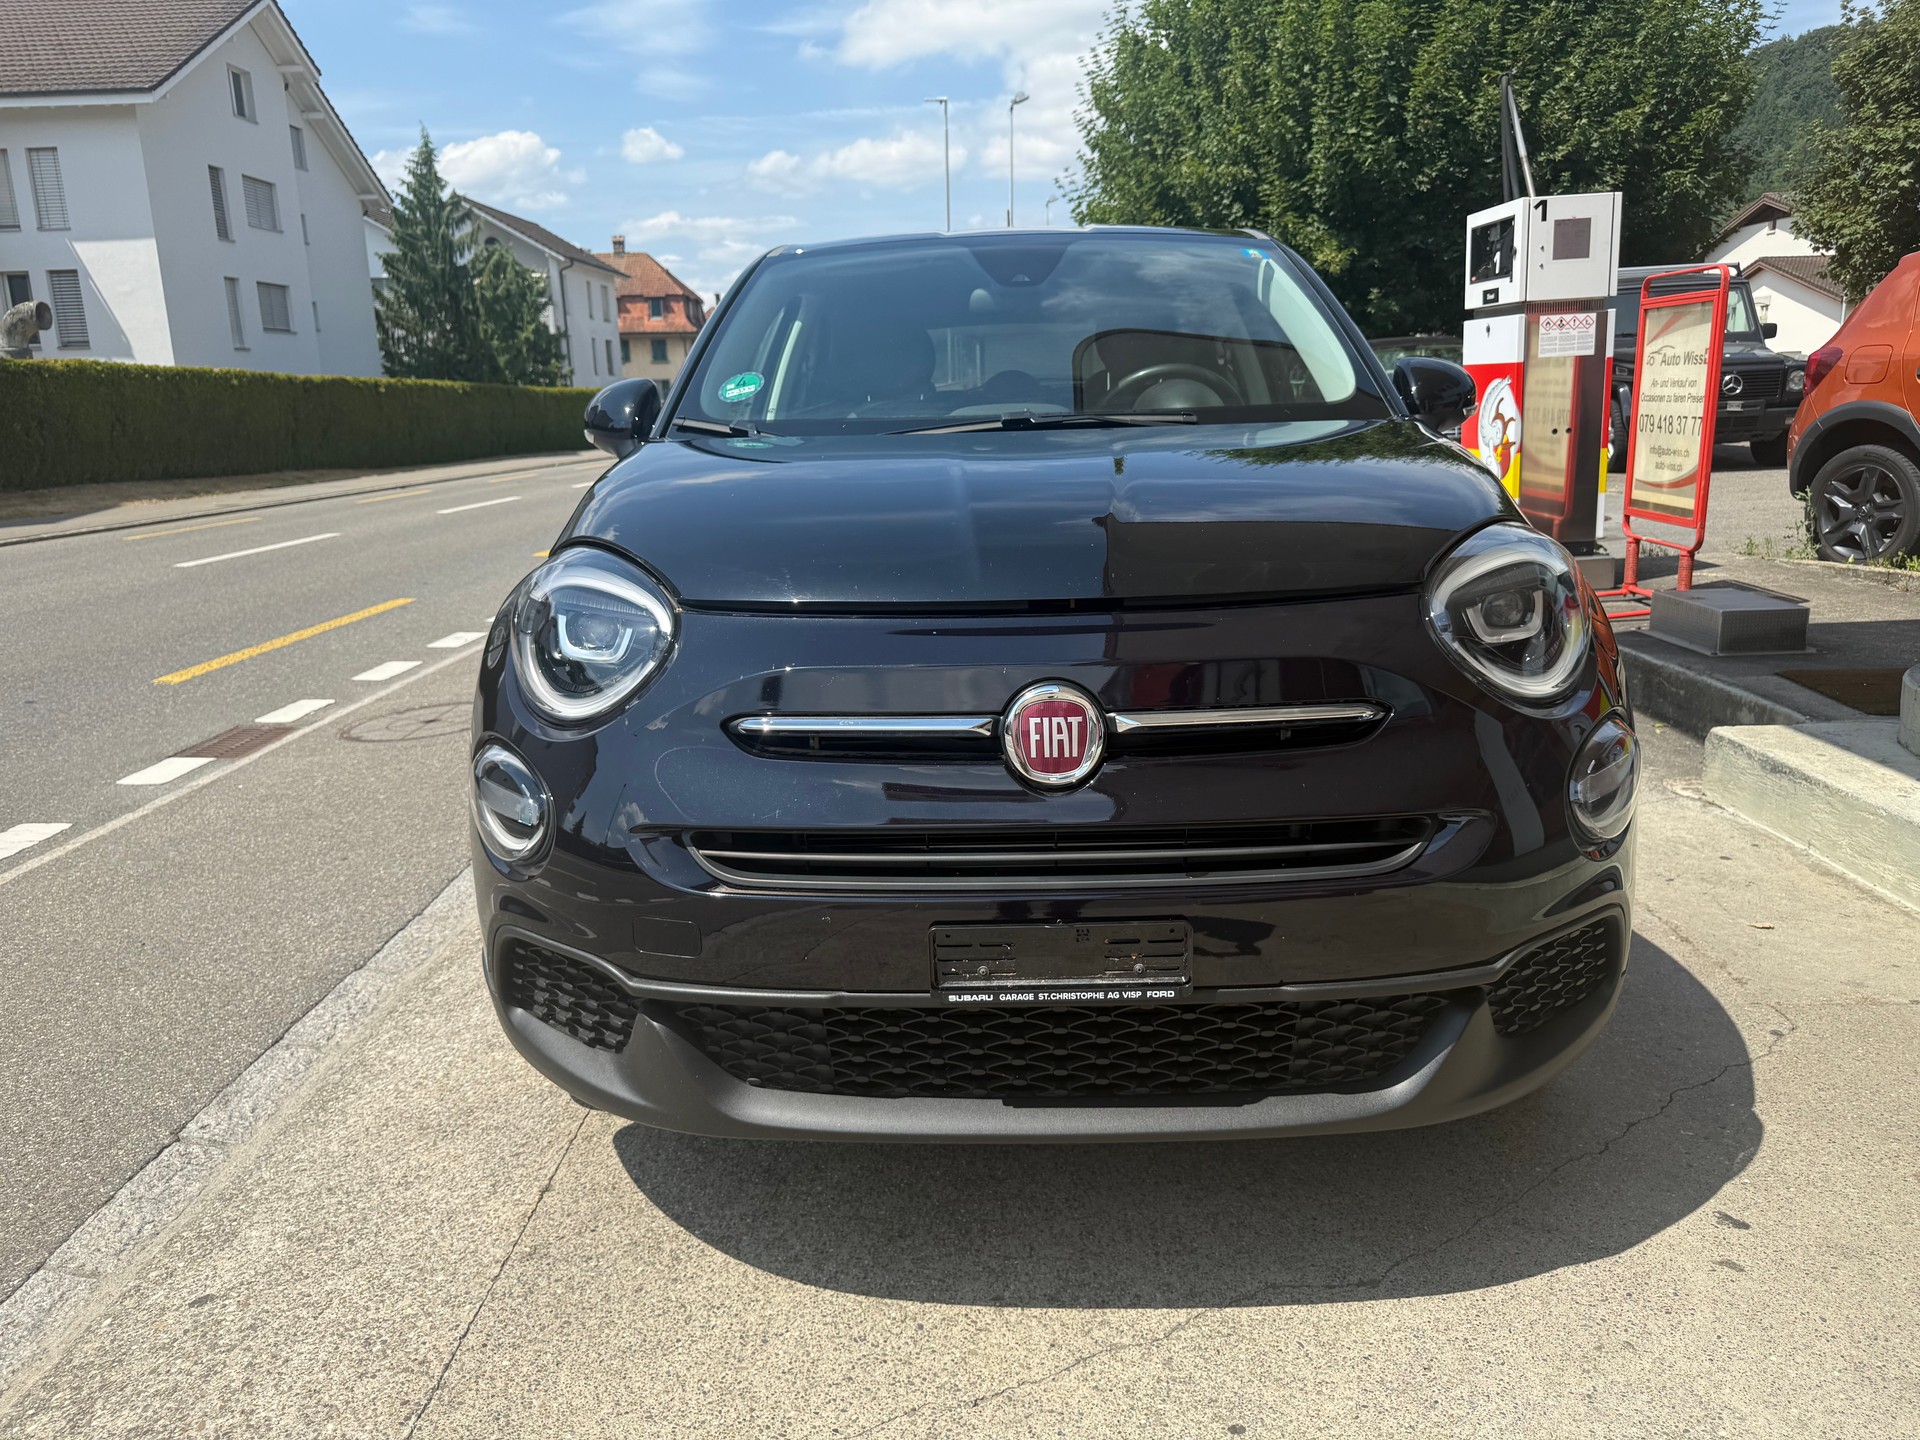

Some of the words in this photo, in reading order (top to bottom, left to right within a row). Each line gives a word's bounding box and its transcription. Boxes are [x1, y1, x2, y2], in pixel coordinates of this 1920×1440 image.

[1533, 199, 1548, 222] 1
[1493, 250, 1501, 274] 1
[1660, 352, 1681, 366] Auto
[1670, 378, 1689, 388] Verkauf
[1640, 392, 1666, 403] Occasionen
[1666, 394, 1672, 403] zu
[1673, 392, 1687, 403] fairen
[1639, 414, 1655, 433] 079
[1657, 414, 1674, 435] 418
[1676, 415, 1688, 436] 37
[1691, 415, 1703, 437] 77
[1029, 716, 1083, 758] FIAT
[948, 994, 994, 1002] SUBARU
[999, 993, 1035, 1001] GARAGE
[1038, 991, 1105, 1001] ST.CHRISTOPHE
[1107, 991, 1120, 999] AG
[1122, 991, 1142, 999] VISP
[1146, 990, 1175, 998] FORD
